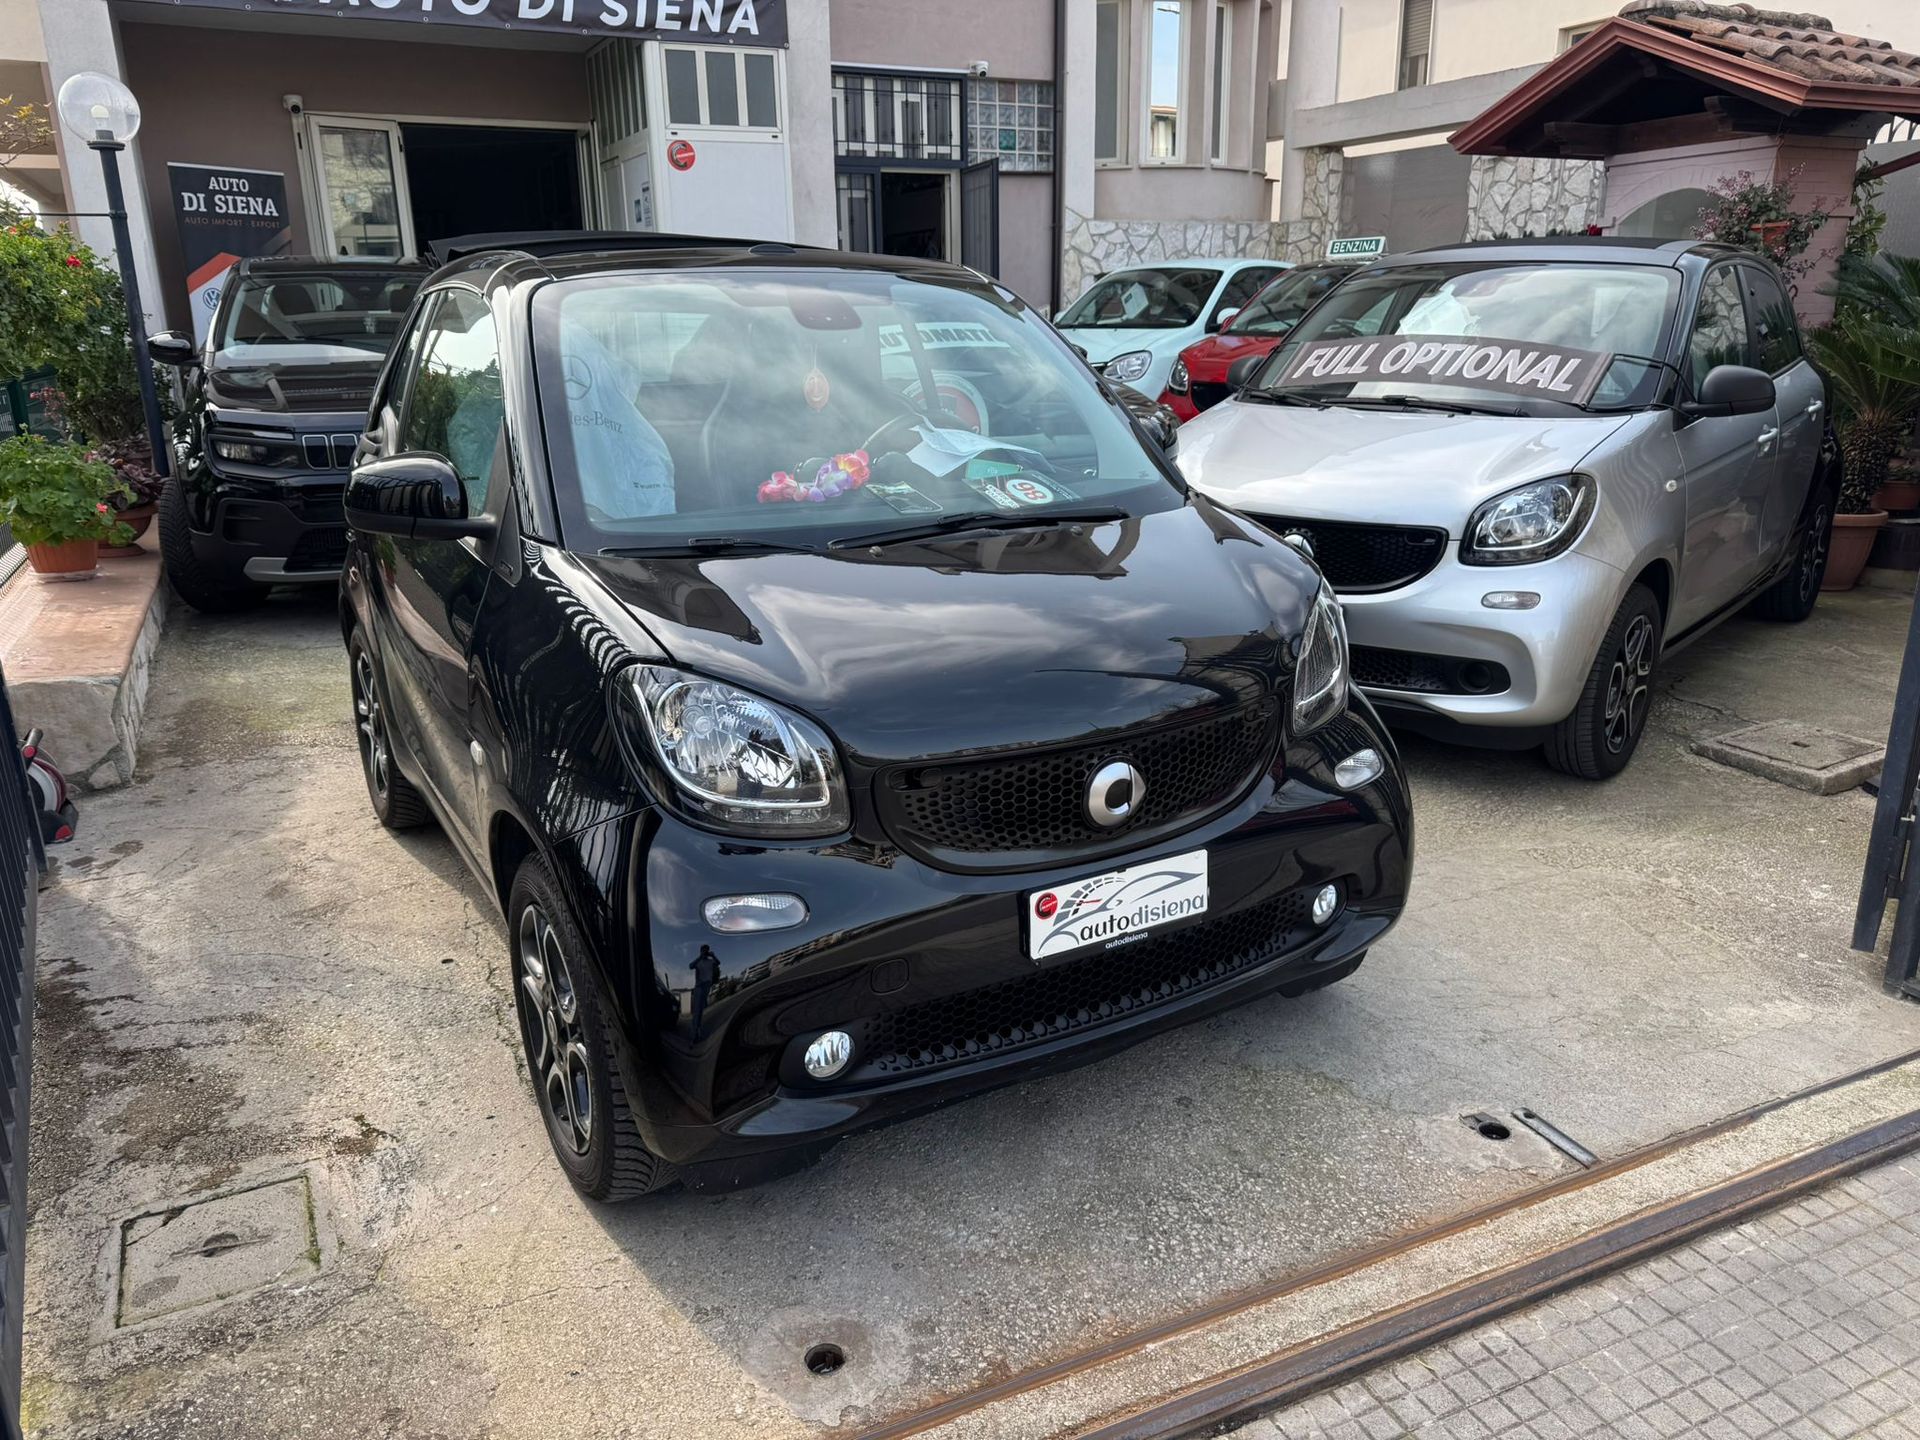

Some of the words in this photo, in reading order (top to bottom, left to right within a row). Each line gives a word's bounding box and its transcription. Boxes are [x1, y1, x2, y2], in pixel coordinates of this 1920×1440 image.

[600, 0, 760, 35] SIENA
[208, 176, 249, 192] AUTO
[181, 192, 207, 212] DI
[214, 194, 279, 217] SIENA
[184, 217, 209, 225] AUTO
[211, 218, 243, 227] IMPORT
[251, 220, 280, 229] EXPORT
[1332, 240, 1376, 253] BENZINA
[1291, 342, 1380, 379] FULL
[1379, 341, 1582, 392] OPTIONAL
[1080, 893, 1204, 941] autodisiena
[1105, 931, 1149, 949] autodisiena
